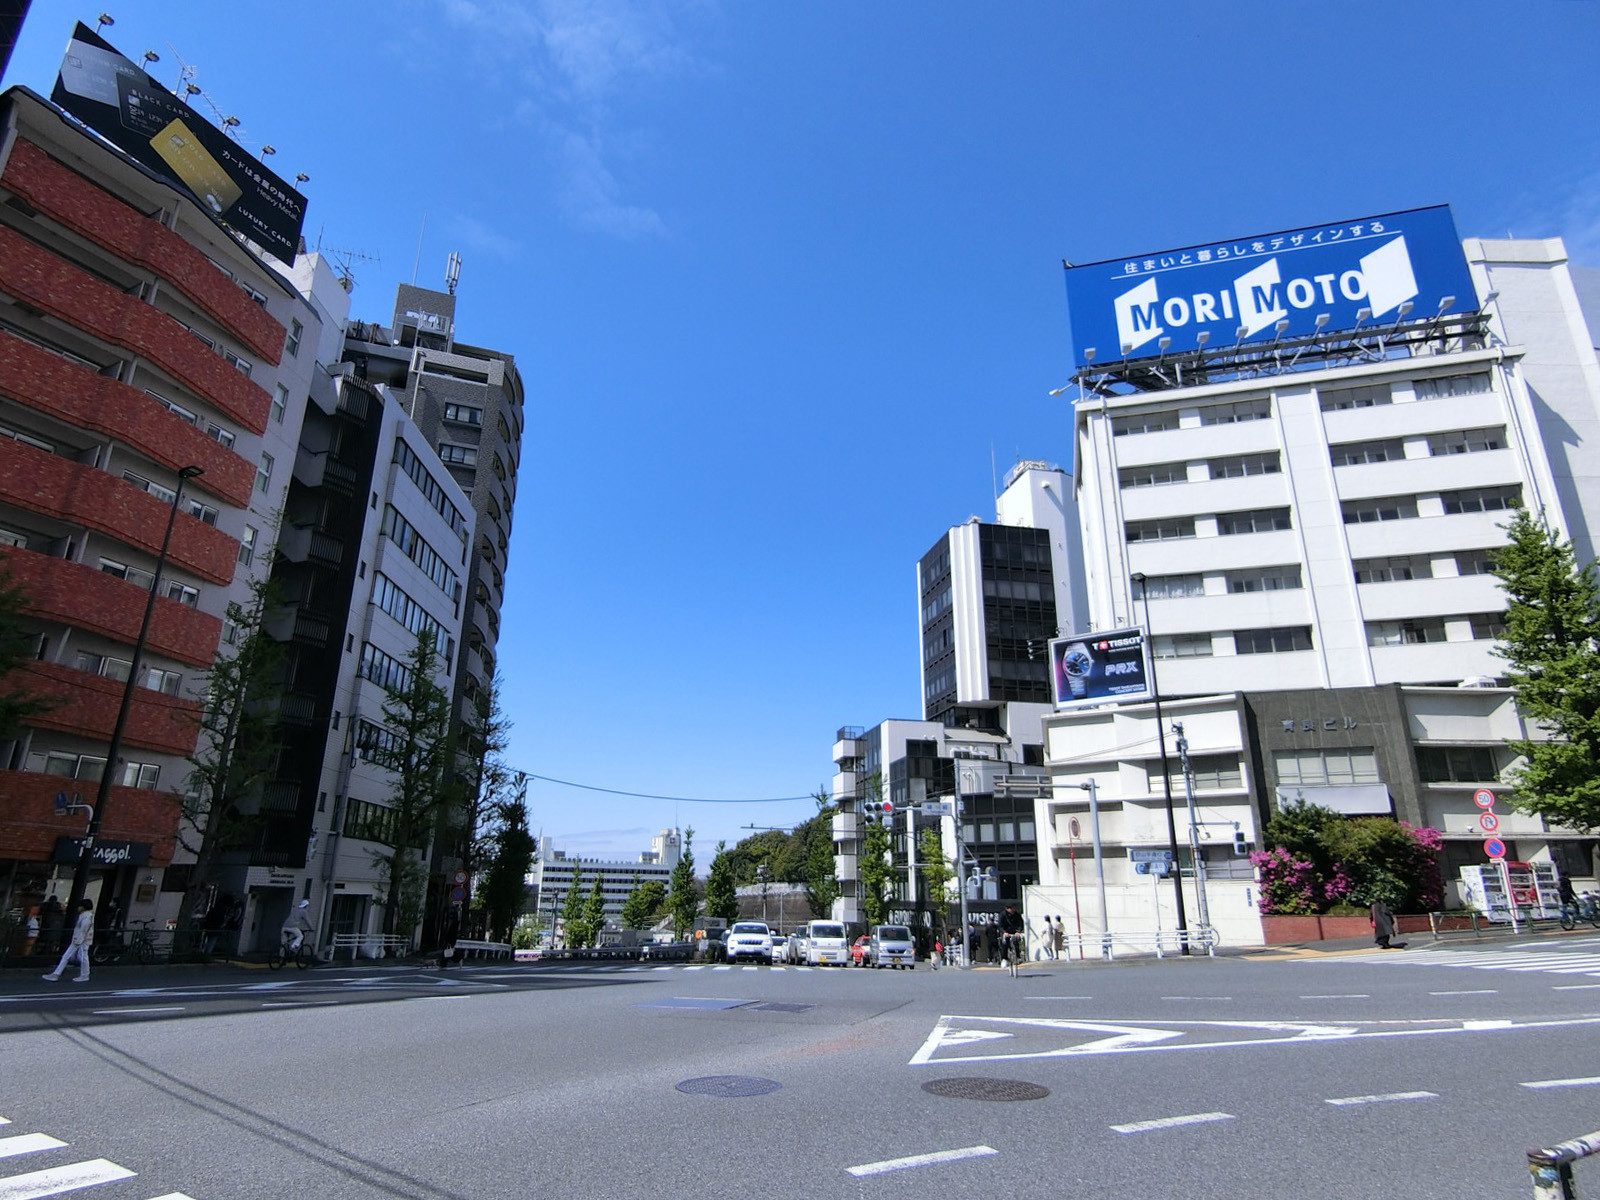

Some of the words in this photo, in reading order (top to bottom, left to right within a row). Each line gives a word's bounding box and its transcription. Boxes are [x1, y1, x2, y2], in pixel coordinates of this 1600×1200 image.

[238, 206, 269, 230] LUXURY
[1123, 221, 1385, 274] 住まいと暮らしをデザインする
[1108, 636, 1143, 648] TISSOT
[1105, 661, 1138, 677] PRX
[1478, 793, 1490, 804] 50
